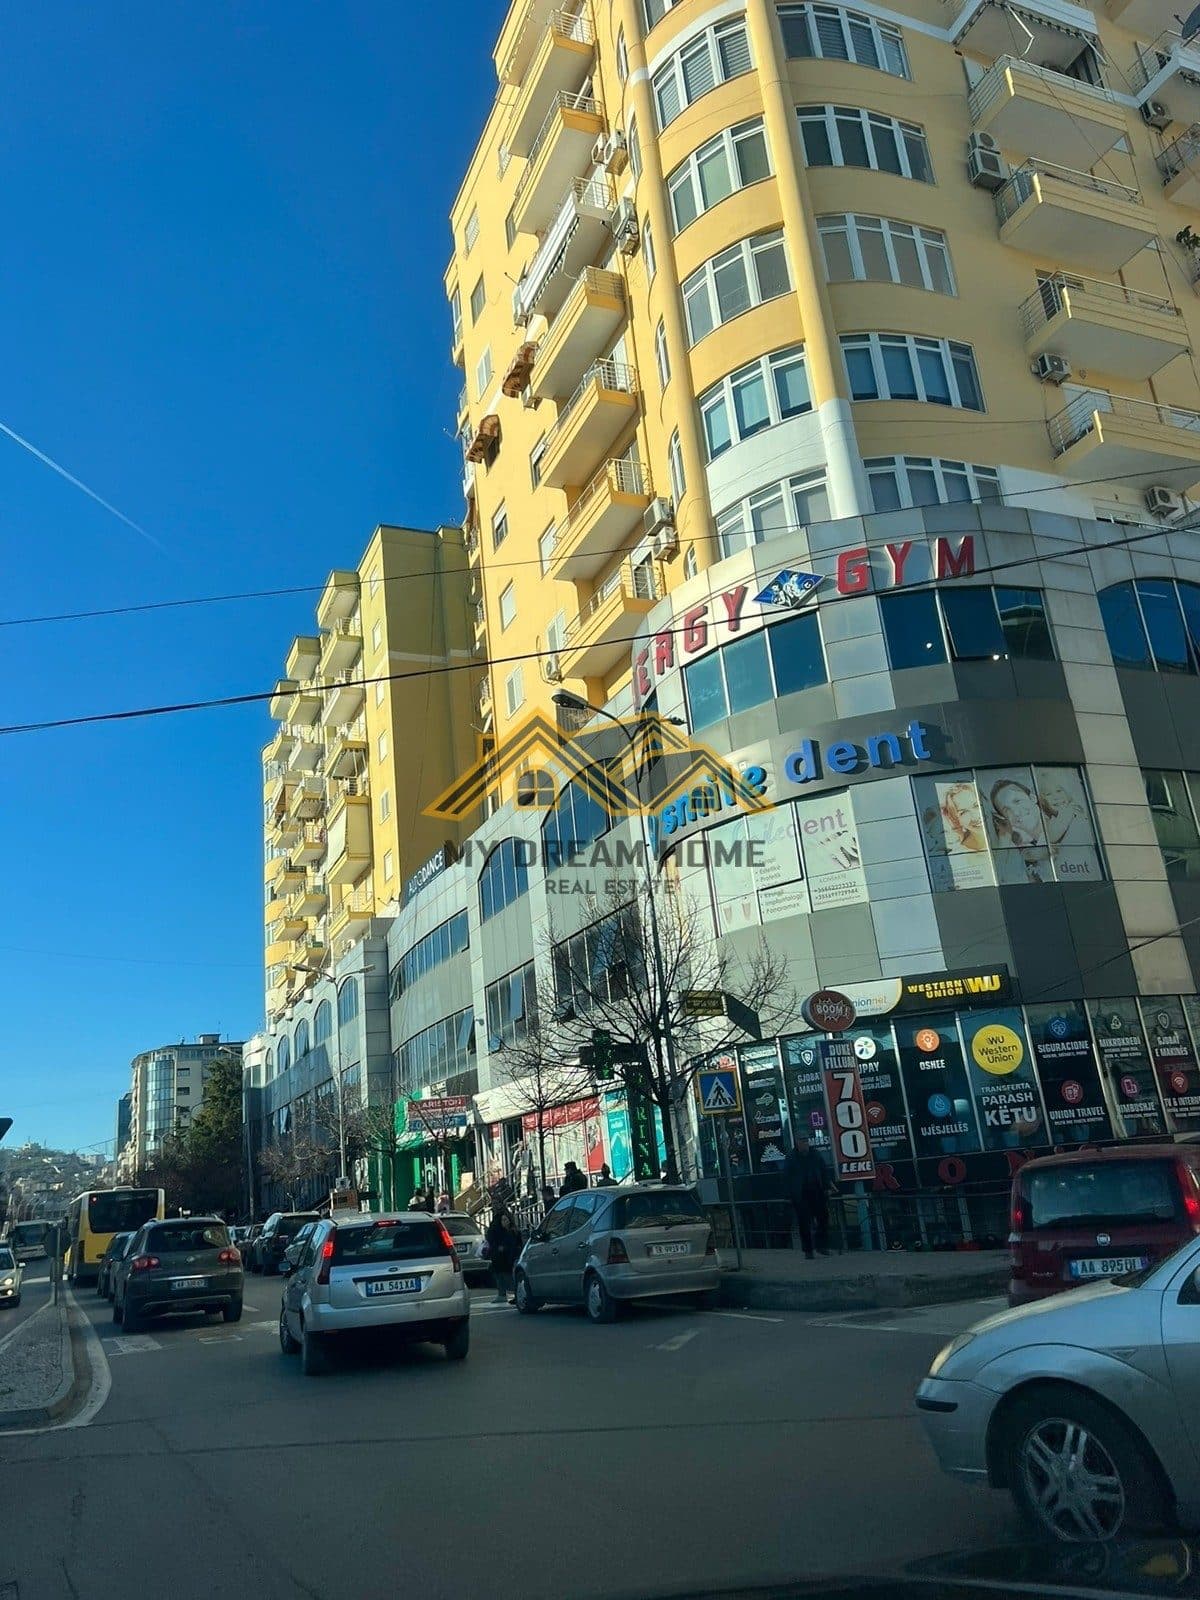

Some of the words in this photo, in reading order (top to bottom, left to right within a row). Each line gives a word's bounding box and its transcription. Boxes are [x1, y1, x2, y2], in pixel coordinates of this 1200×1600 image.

[837, 535, 975, 594] GYM
[784, 719, 931, 784] dent
[1060, 861, 1089, 874] dent
[907, 979, 964, 994] WESTERN
[969, 975, 1001, 994] WU
[925, 988, 964, 999] UNION
[854, 995, 887, 1008] nionnet
[988, 1036, 1005, 1045] WU
[1037, 1040, 1090, 1053] SIGURACIONE
[978, 1044, 1019, 1057] Western
[919, 1059, 946, 1071] OSHEE
[987, 1053, 1015, 1064] Union
[981, 1082, 1032, 1093] TRANSFERTA
[982, 1092, 1034, 1106] PARASH
[984, 1105, 1037, 1127] KËTU
[1049, 1109, 1076, 1120] UNION
[1076, 1106, 1106, 1118] TRAVEL
[870, 1125, 905, 1138] INTERNET
[921, 1122, 969, 1136] UJËSJELLËS
[1081, 1261, 1096, 1274] AA
[374, 1283, 385, 1292] AA
